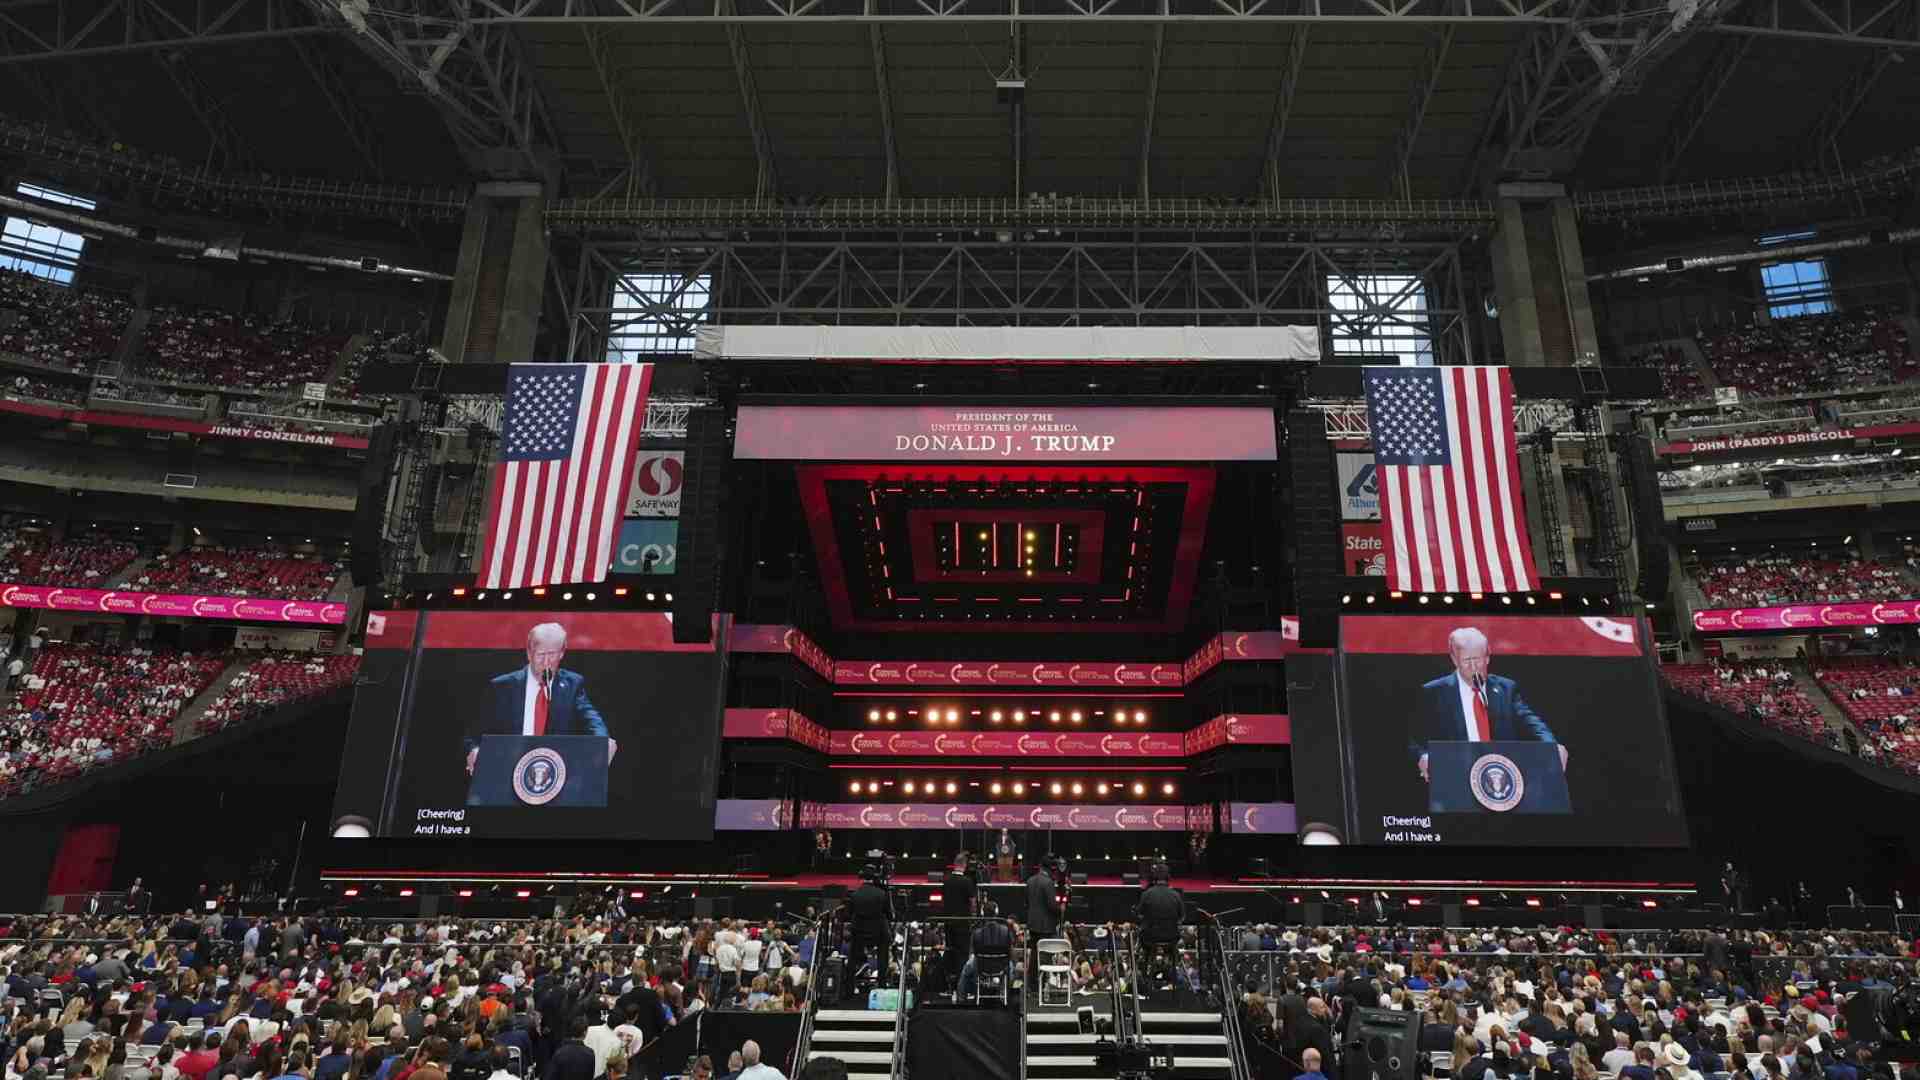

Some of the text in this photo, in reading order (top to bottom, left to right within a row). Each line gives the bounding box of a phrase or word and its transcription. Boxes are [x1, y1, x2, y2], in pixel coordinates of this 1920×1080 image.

[956, 413, 1053, 421] PRESIDENT OF THE
[931, 424, 1078, 432] UNITED STATES OF AMERICA
[208, 426, 334, 445] JIMMY CONZELMAN
[1691, 430, 1854, 452] JOHN (PADDY) DRISCOLL
[896, 435, 1115, 455] DONALD J. TRUMP
[636, 500, 679, 508] SAFEWAY
[1345, 536, 1382, 549] State
[417, 809, 465, 821] [Cheering]
[1383, 816, 1431, 828] [Cheering]
[415, 825, 433, 834] And
[441, 825, 462, 834] have
[1384, 832, 1403, 842] And
[1411, 832, 1433, 842] have
